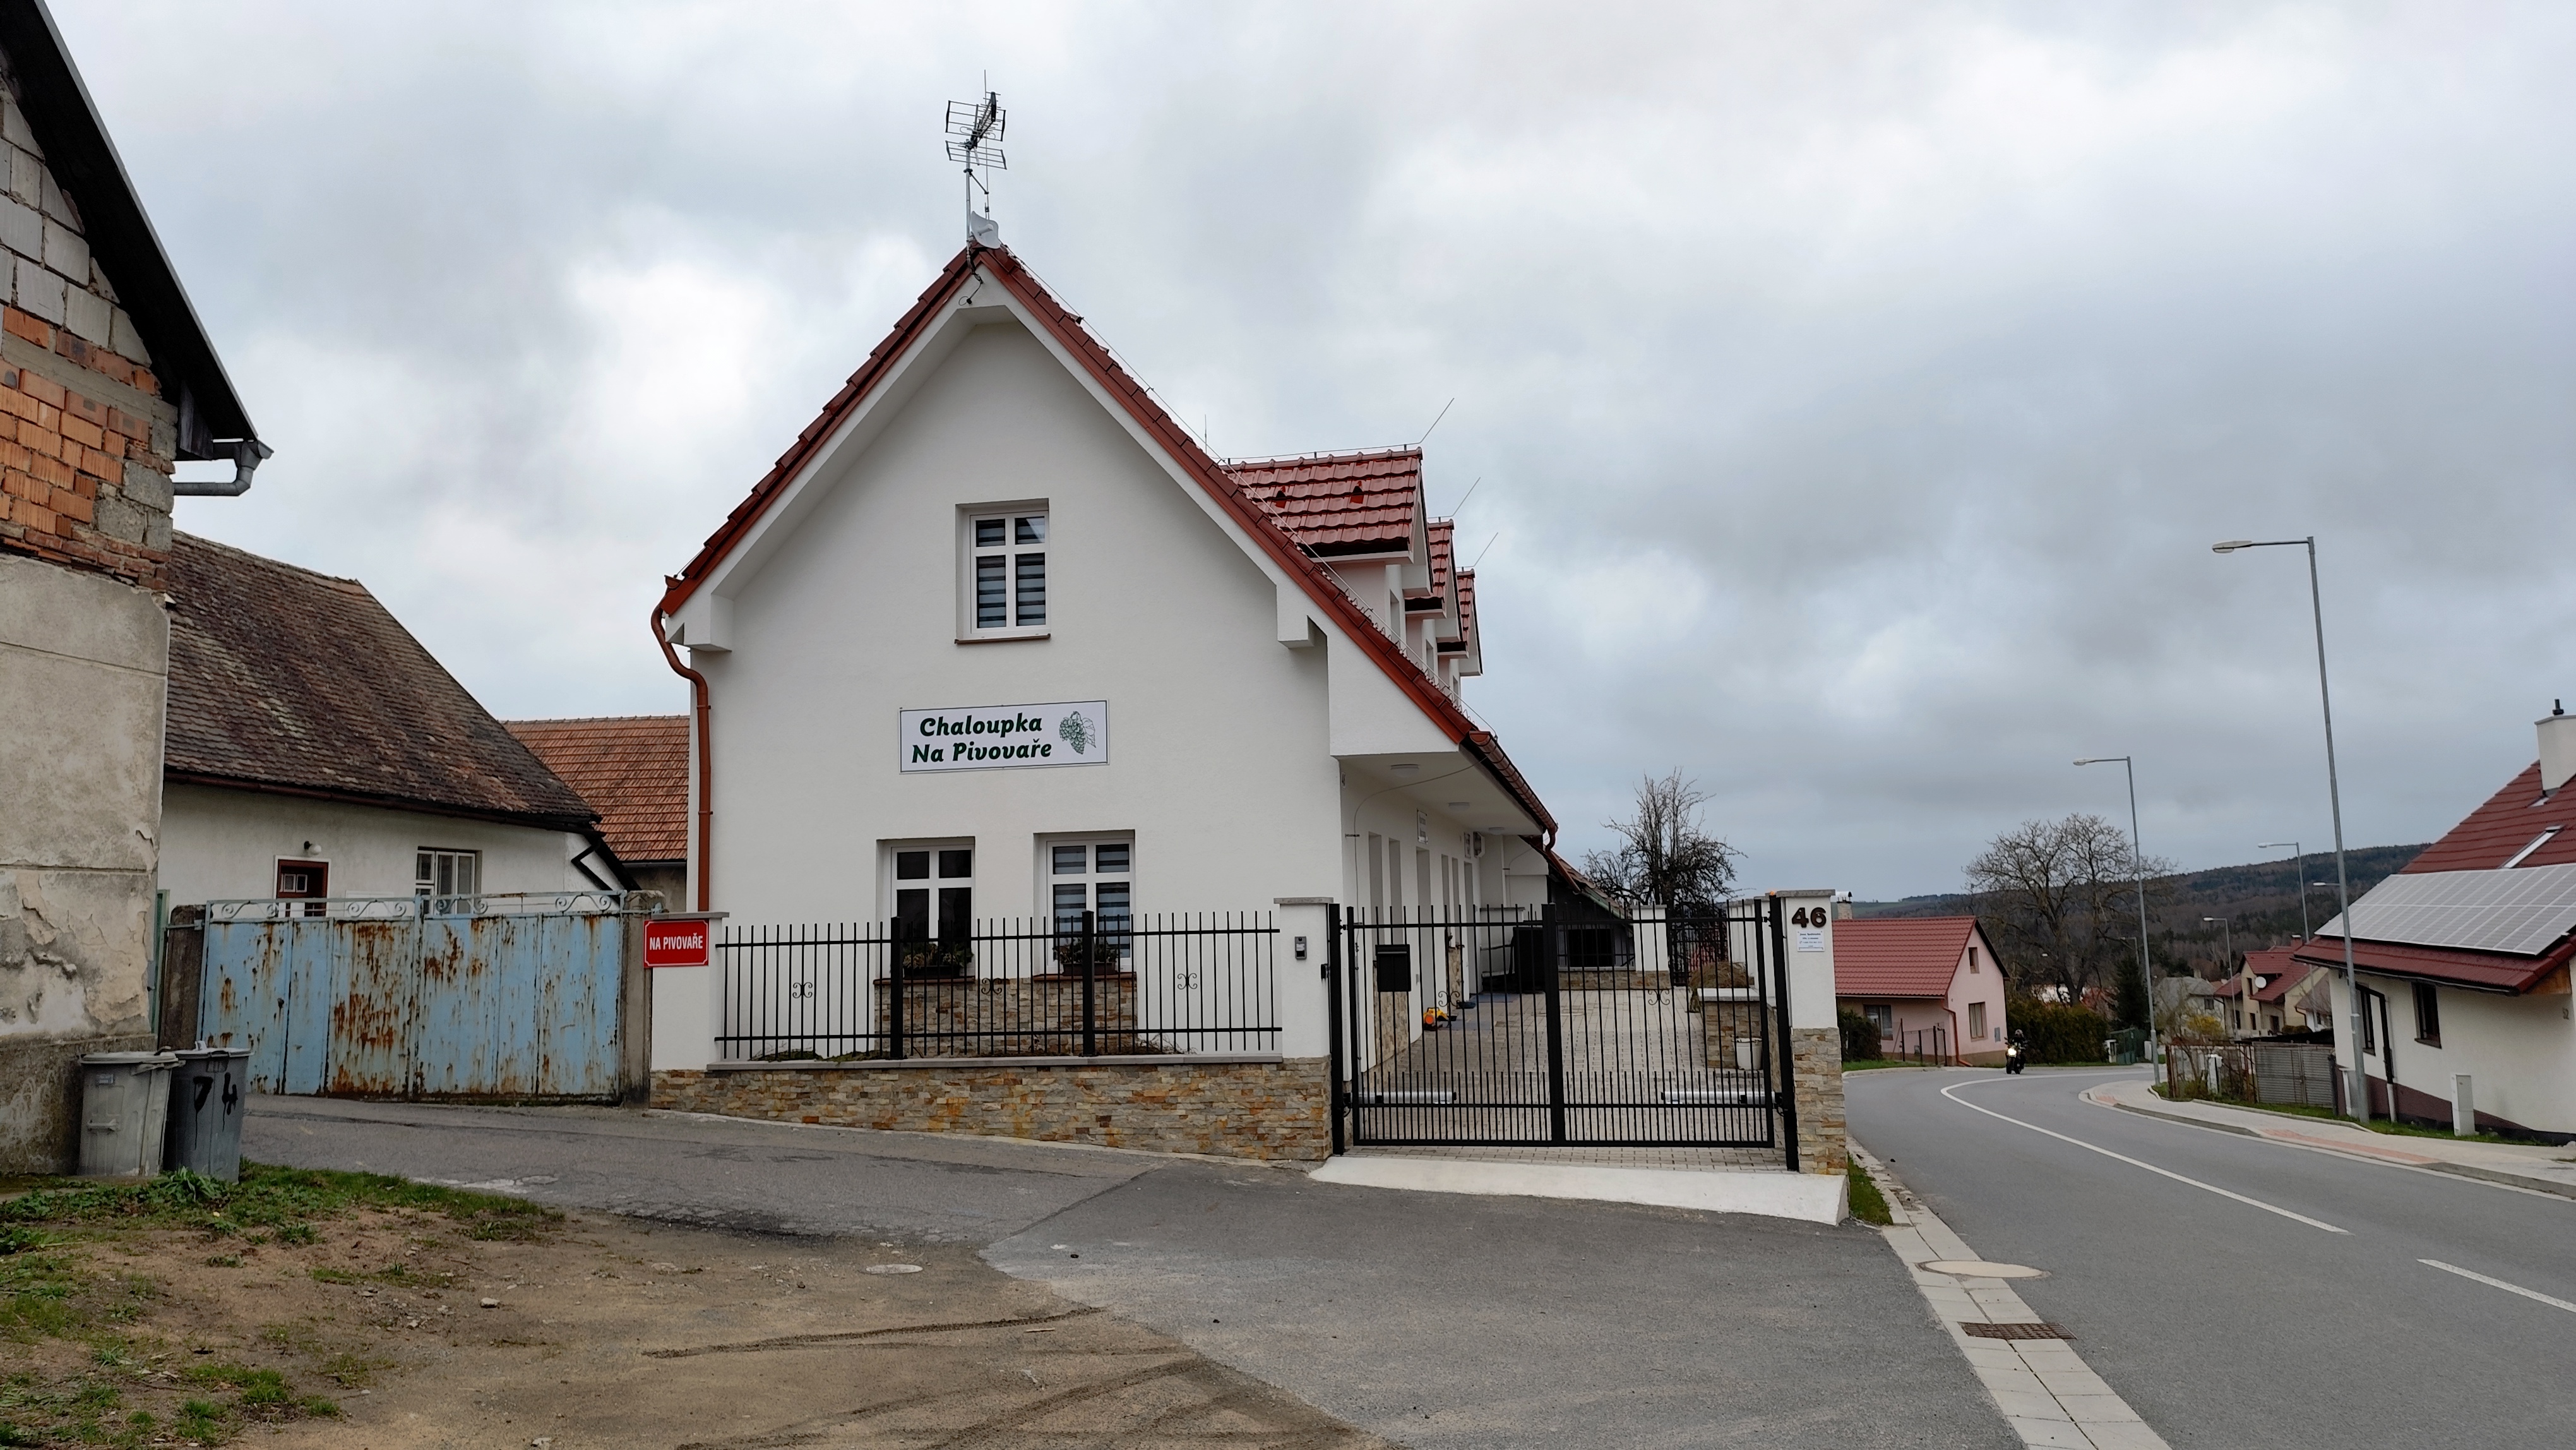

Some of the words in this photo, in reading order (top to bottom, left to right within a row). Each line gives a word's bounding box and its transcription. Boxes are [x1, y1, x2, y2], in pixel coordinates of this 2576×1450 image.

[920, 712, 1042, 738] Chaloupka
[912, 744, 944, 763] Na
[953, 738, 1052, 761] Pivovaře
[1791, 907, 1827, 928] 46
[649, 937, 661, 950] NA
[663, 932, 703, 950] PIVOVAŘE
[193, 1072, 238, 1117] 74
